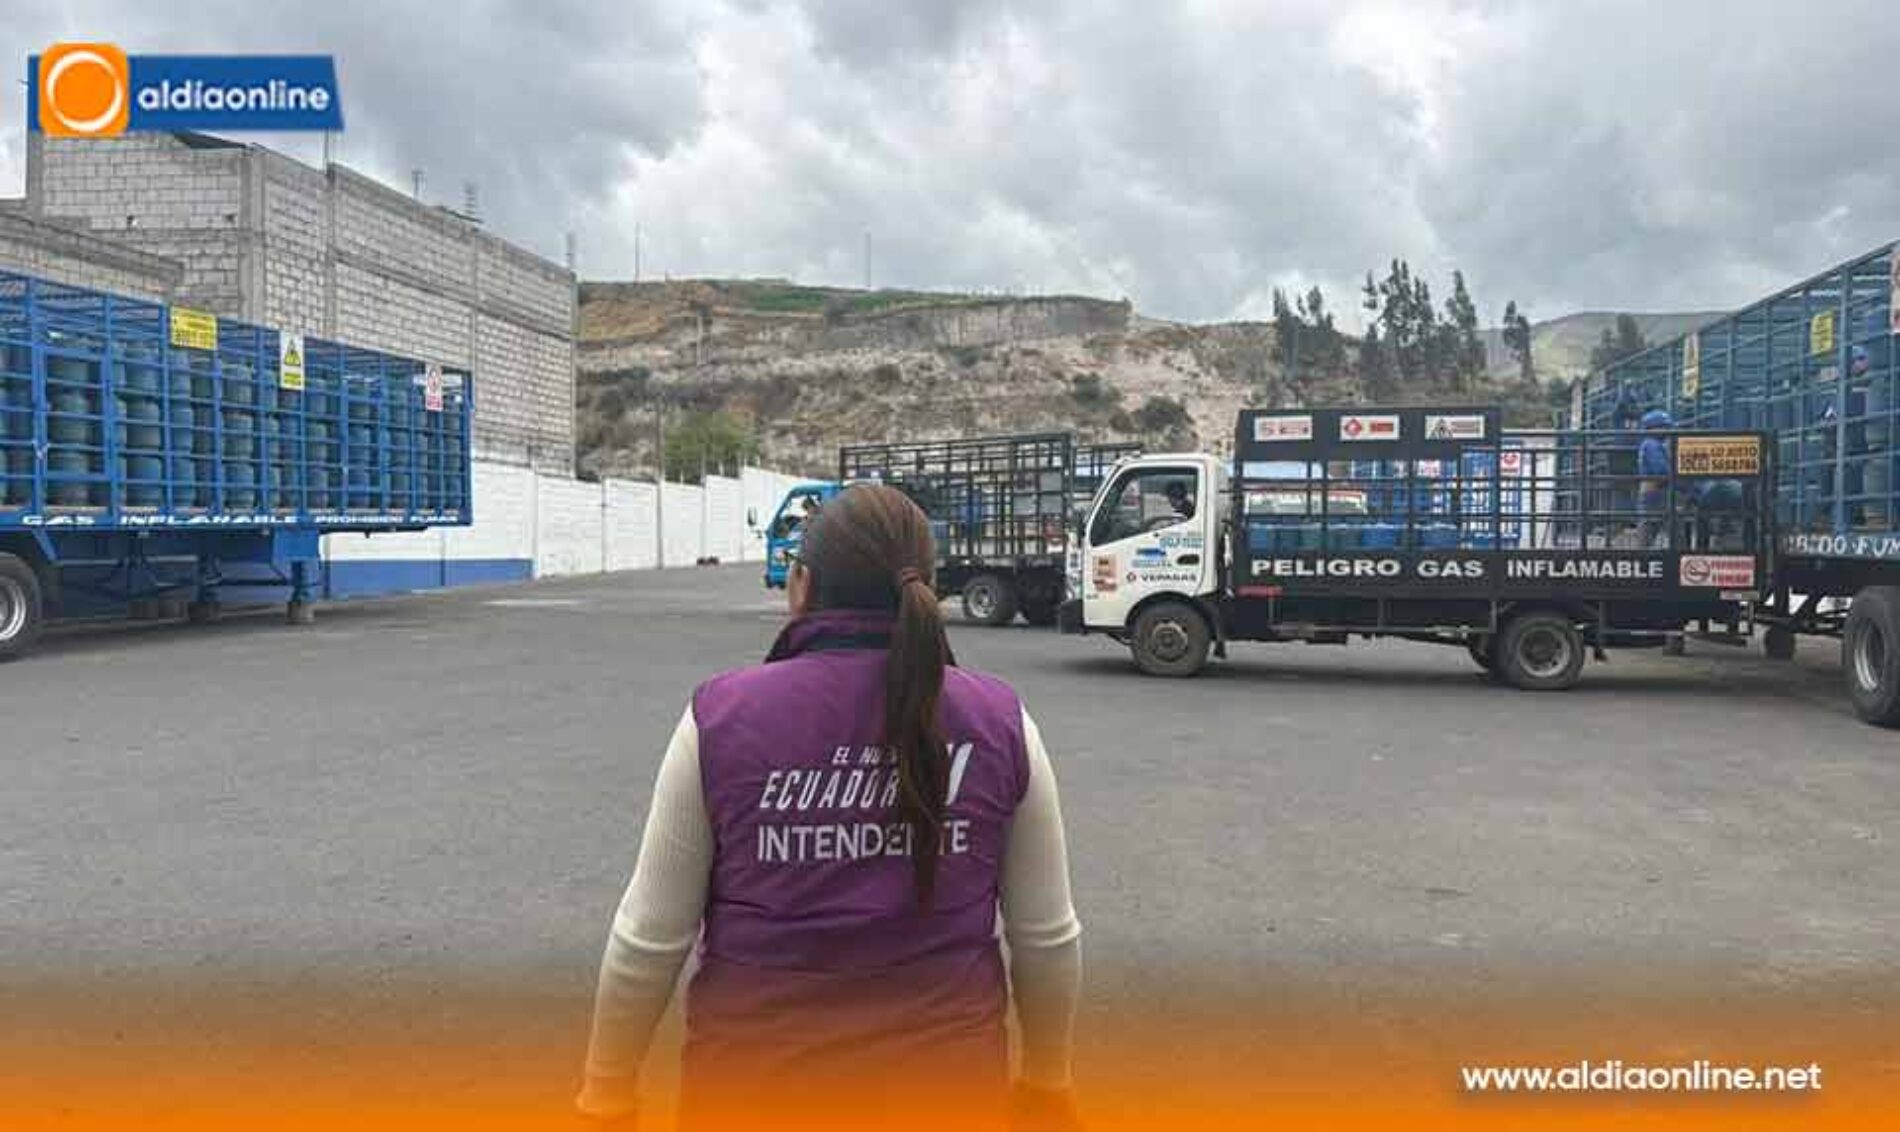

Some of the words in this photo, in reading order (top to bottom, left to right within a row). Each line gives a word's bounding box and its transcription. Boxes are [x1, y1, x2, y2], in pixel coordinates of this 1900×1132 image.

[23, 514, 96, 526] GAS
[1251, 559, 1401, 577] PELIGRO
[1416, 560, 1484, 578] GAS
[1507, 559, 1663, 579] INFLAMABLE
[832, 746, 850, 765] EL
[759, 768, 900, 811] ECUADOR
[758, 819, 971, 862] INTENDETE
